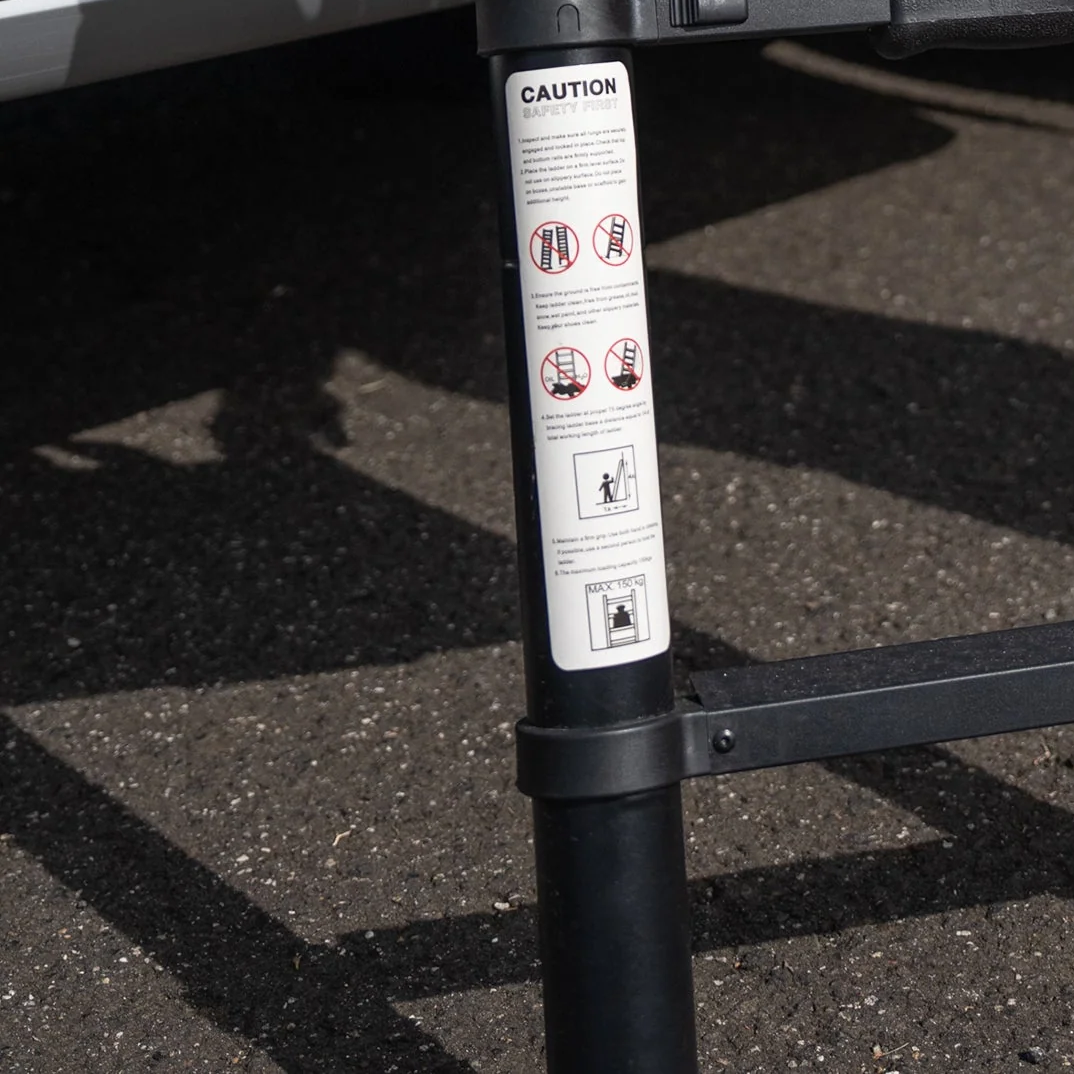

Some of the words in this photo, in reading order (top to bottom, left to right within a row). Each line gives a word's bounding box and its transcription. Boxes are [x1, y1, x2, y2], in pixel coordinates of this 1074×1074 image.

[520, 77, 617, 104] CAUTION
[522, 101, 578, 119] SAFETY
[583, 97, 618, 113] FIRST
[588, 583, 613, 594] MAX
[617, 579, 634, 589] 150
